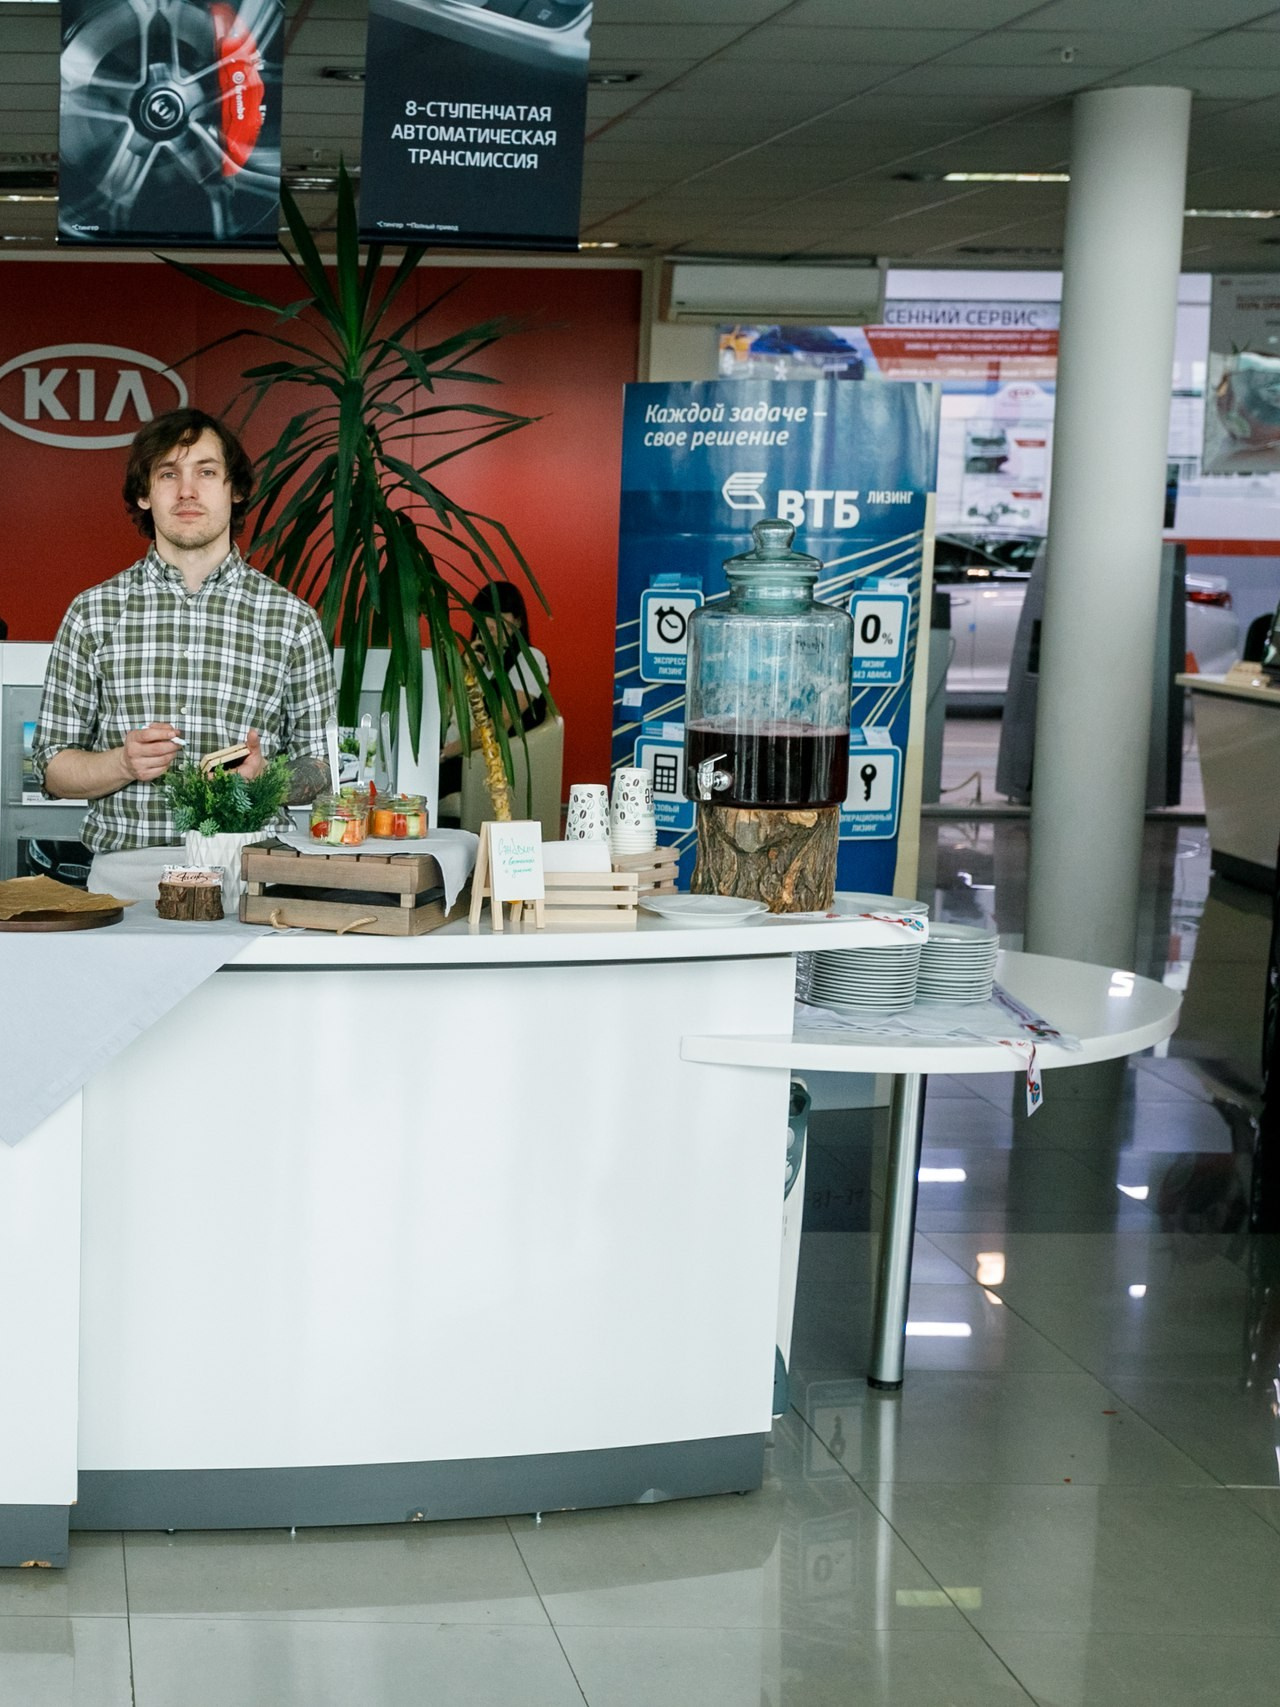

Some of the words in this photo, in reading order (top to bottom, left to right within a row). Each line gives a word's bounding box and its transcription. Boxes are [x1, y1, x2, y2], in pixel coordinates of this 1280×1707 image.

[405, 100, 552, 122] 8-СТУПЕНЧАТАЯ
[391, 124, 557, 146] АВТОМАТИЧЕСКАЯ
[407, 148, 539, 169] ТРАНСМИССИЯ
[966, 309, 1039, 326] СЕРВИС
[22, 368, 155, 422] KIA
[645, 402, 724, 424] Каждой
[728, 402, 808, 423] задаче
[644, 430, 687, 447] свое
[690, 430, 790, 451] решение
[777, 489, 861, 529] ВТБ
[866, 491, 914, 505] ЛИЗИНГ
[861, 614, 893, 645] 0%
